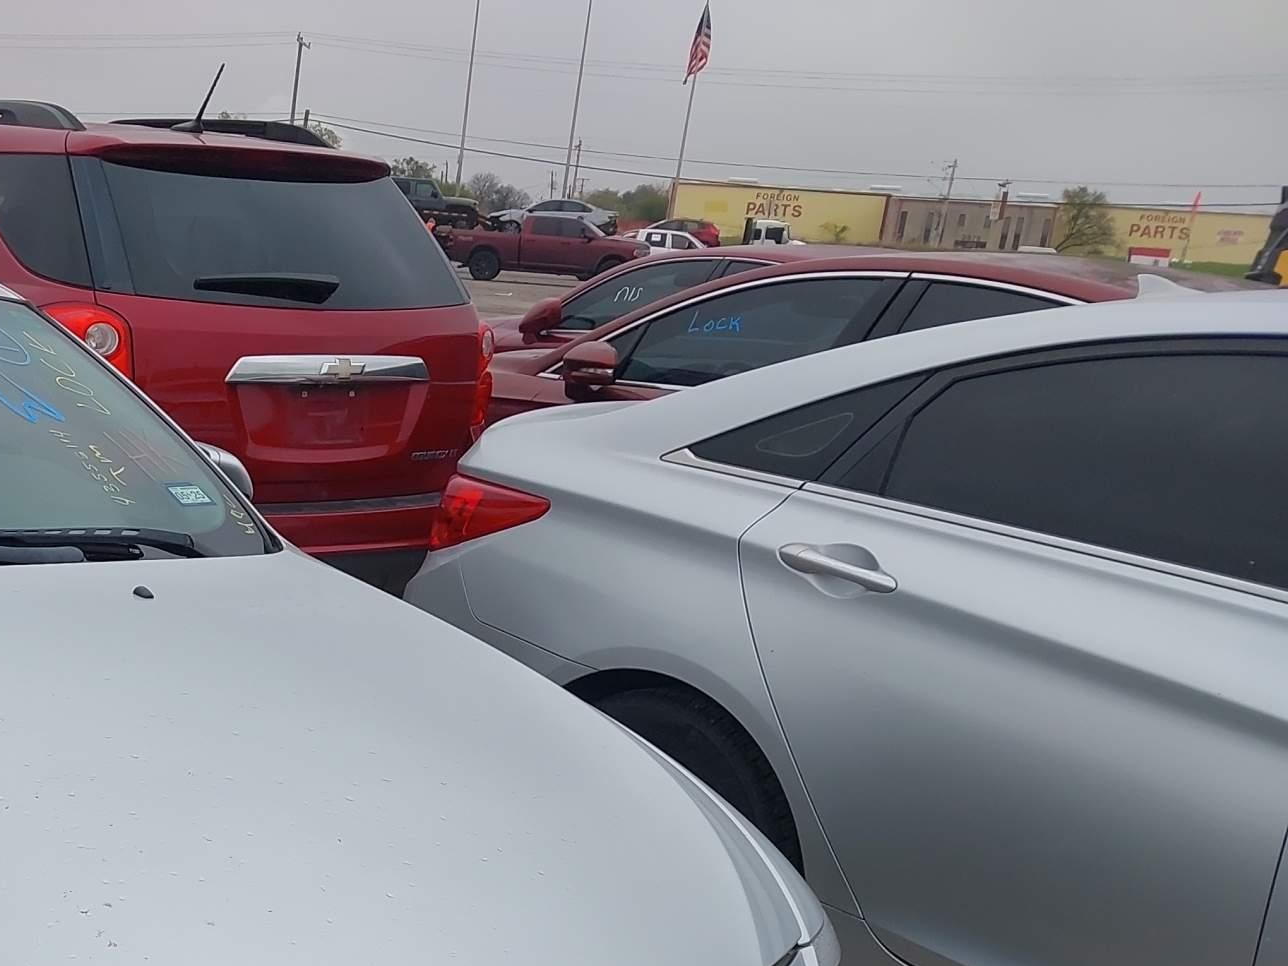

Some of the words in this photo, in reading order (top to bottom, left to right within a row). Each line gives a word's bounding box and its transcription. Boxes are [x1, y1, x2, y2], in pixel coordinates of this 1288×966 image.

[745, 202, 802, 217] PARTS
[1139, 214, 1186, 223] FOREIGN
[1128, 223, 1190, 240] PARTS
